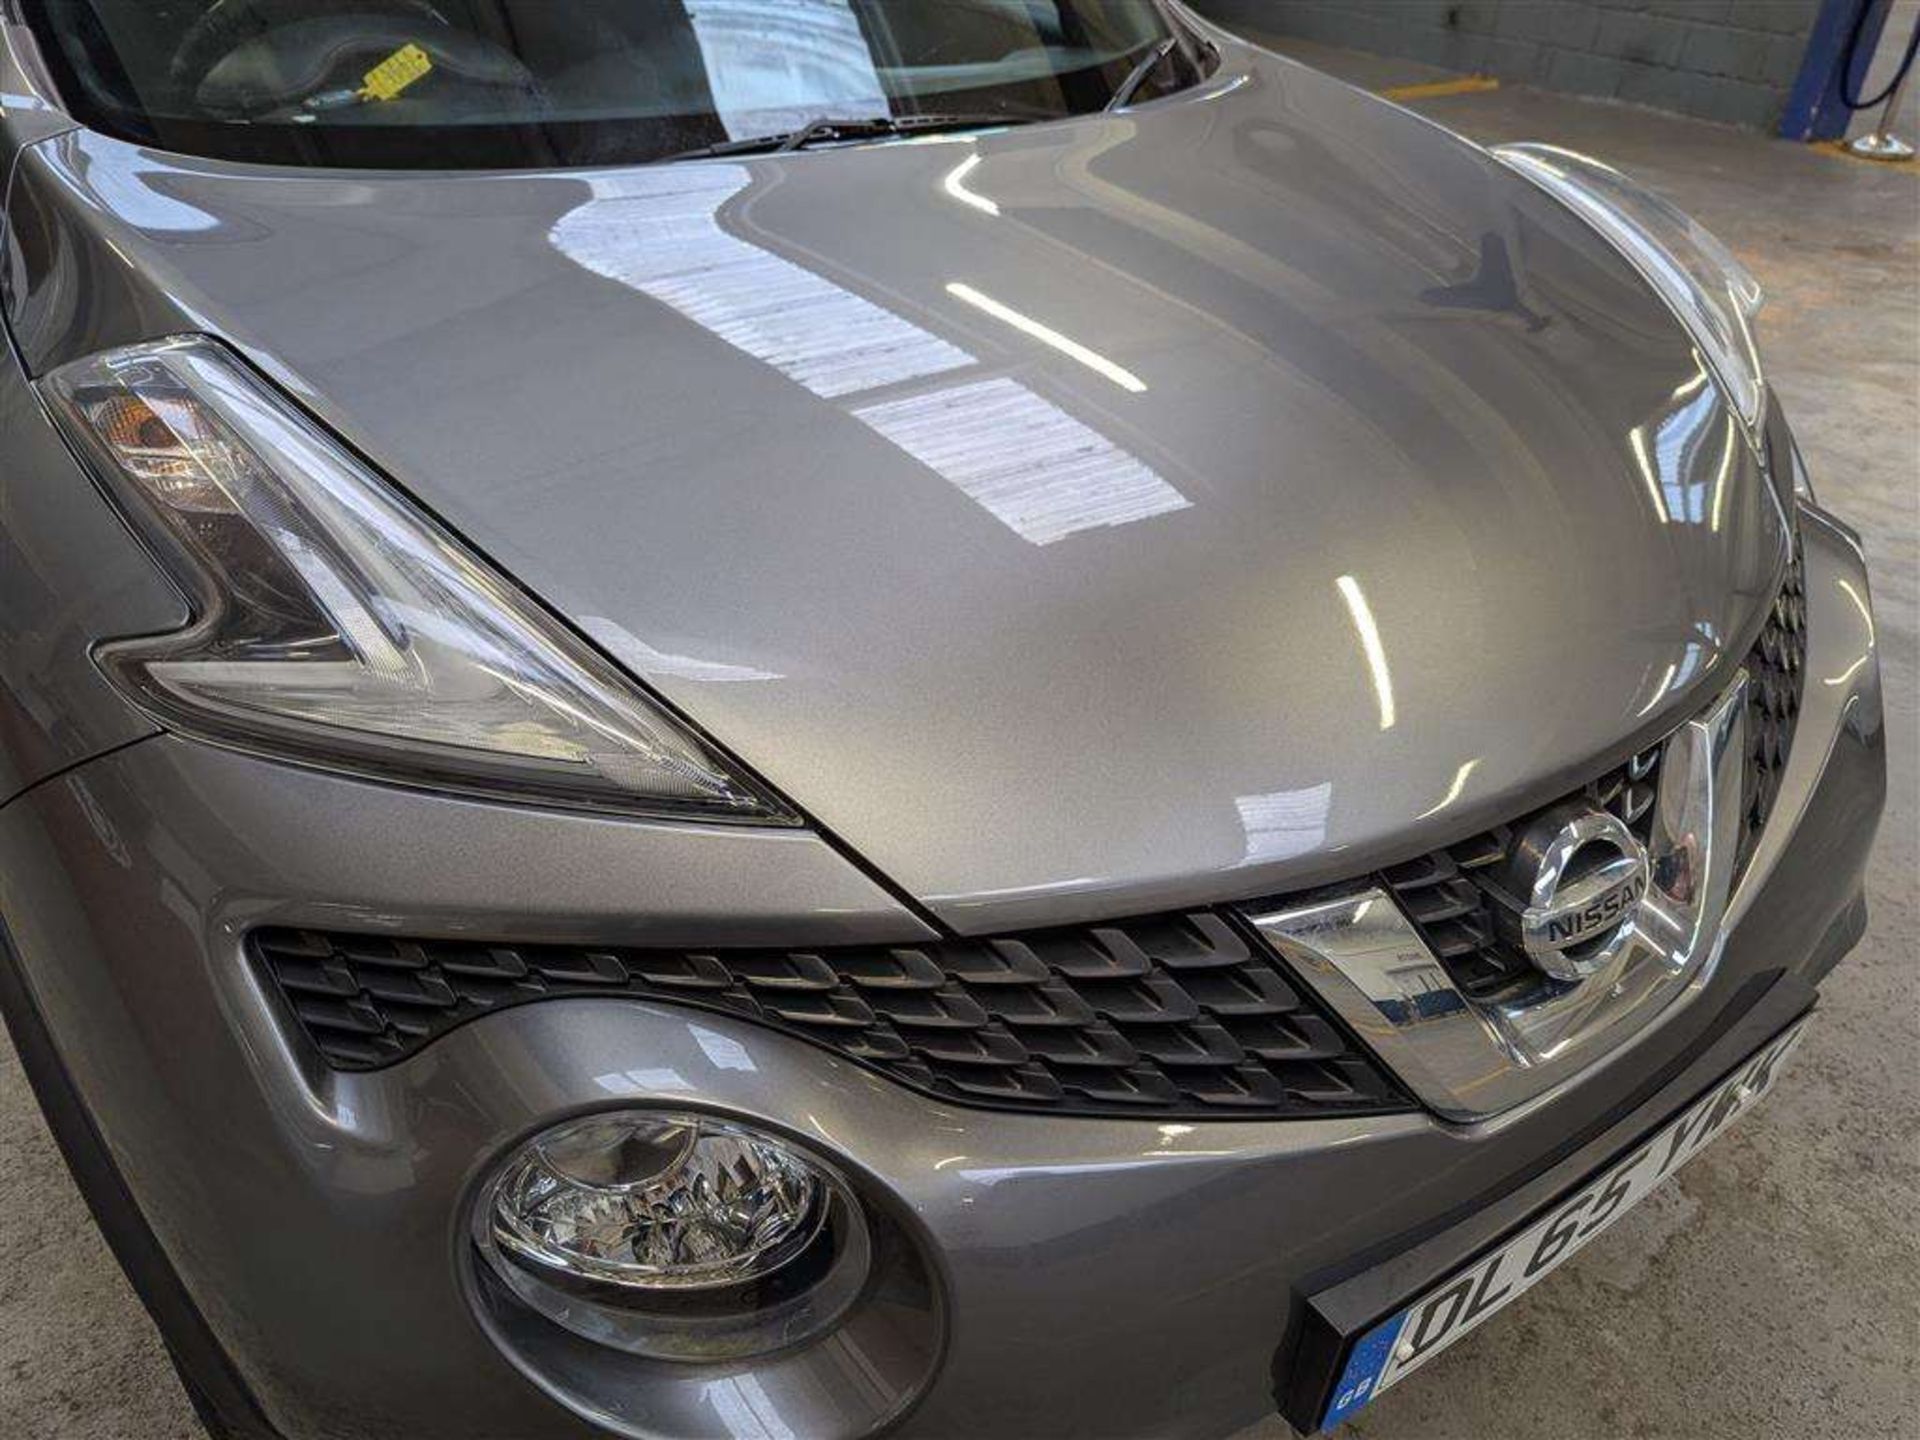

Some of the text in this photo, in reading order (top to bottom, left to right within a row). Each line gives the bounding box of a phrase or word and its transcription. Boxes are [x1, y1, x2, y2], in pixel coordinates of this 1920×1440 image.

[1548, 876, 1645, 942] NISSAN
[1396, 1145, 1653, 1369] DL65
[1336, 1377, 1372, 1410] GB
